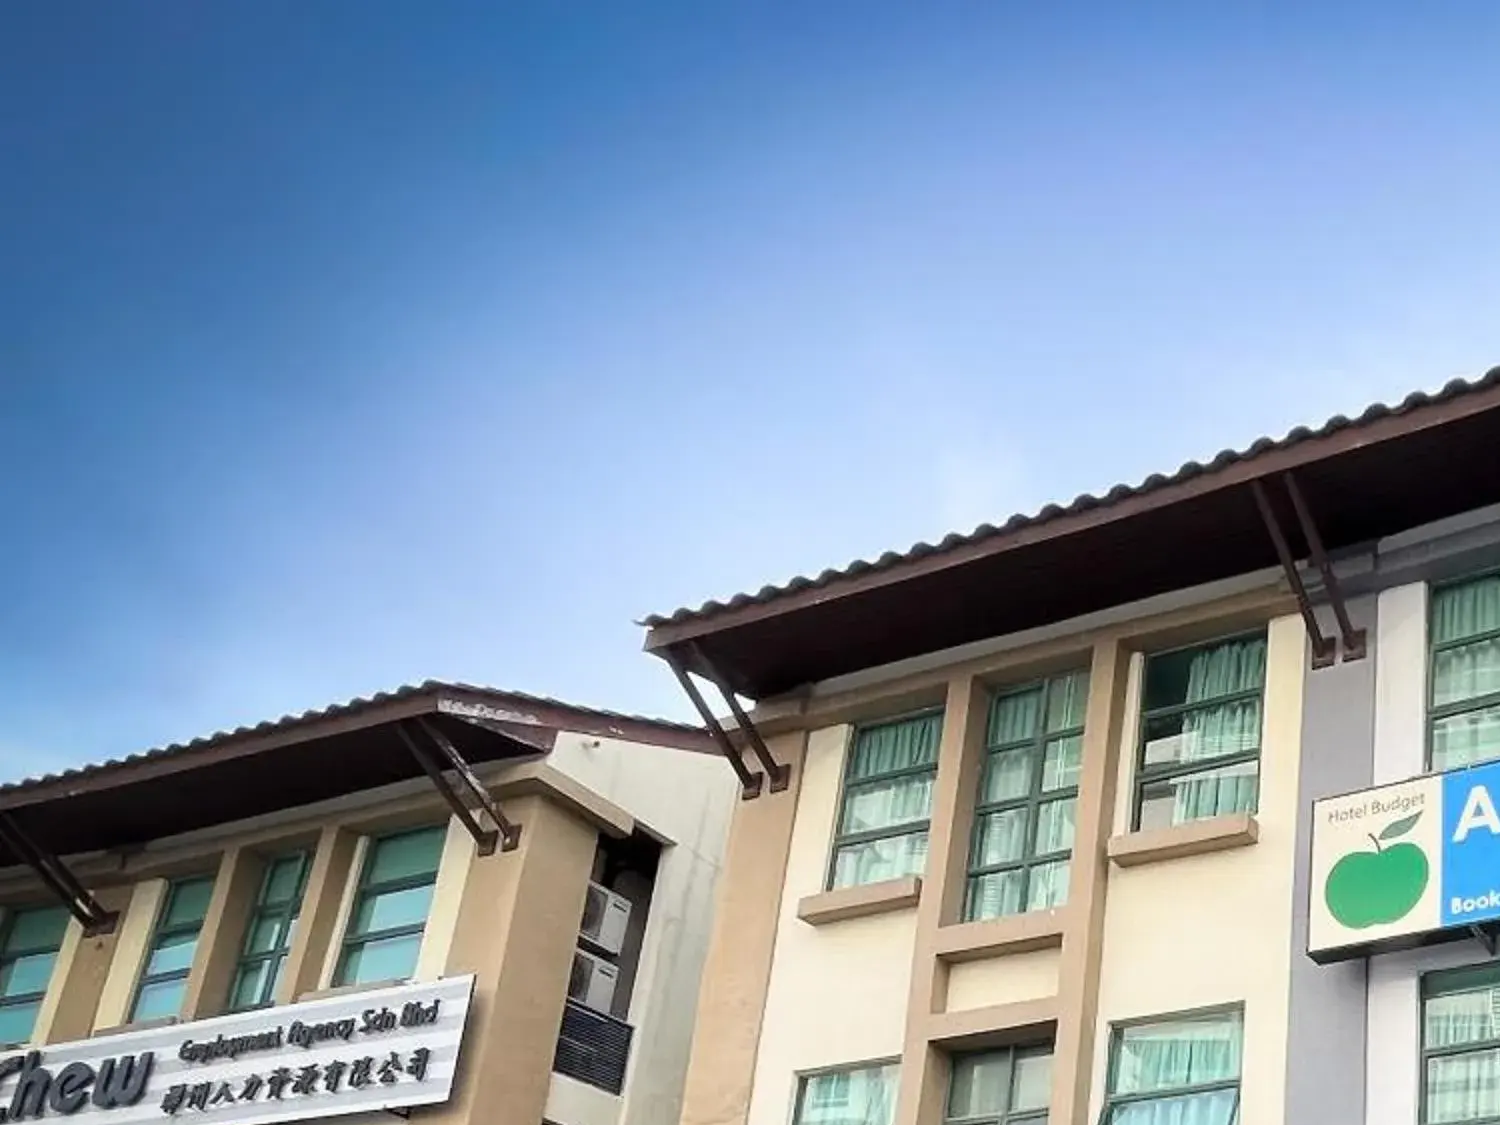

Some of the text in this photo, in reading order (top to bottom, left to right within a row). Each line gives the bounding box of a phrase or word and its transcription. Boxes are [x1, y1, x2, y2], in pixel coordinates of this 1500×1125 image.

[1328, 792, 1427, 826] Hotel Budget
[286, 1018, 357, 1049] Agency
[358, 1006, 398, 1033] Sdn
[400, 998, 441, 1028] Bhd
